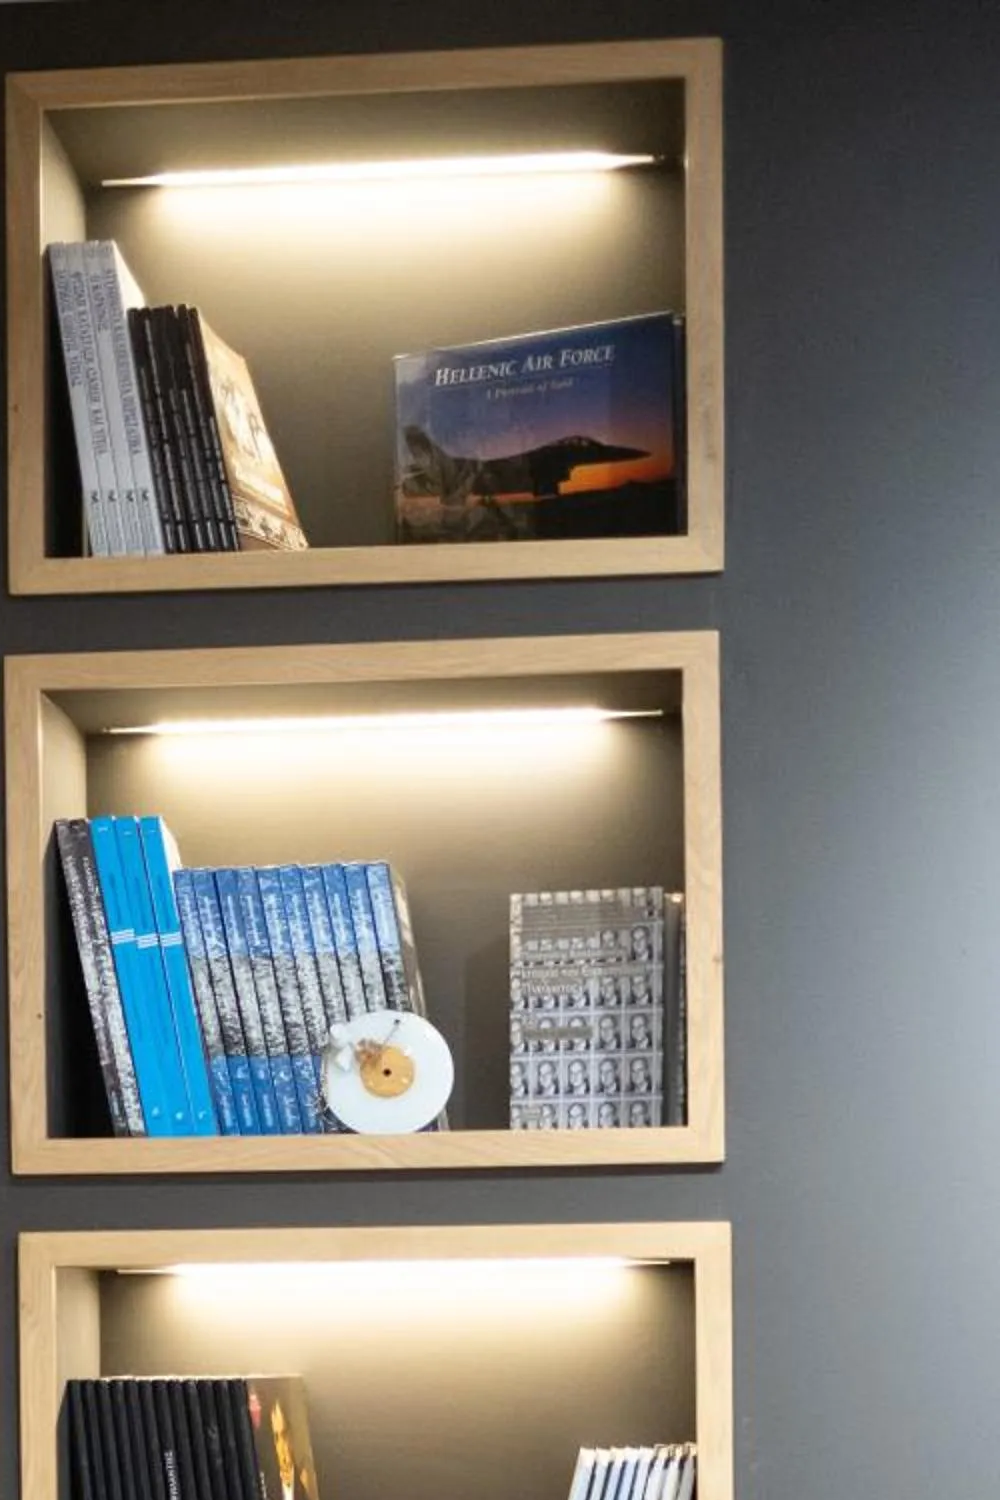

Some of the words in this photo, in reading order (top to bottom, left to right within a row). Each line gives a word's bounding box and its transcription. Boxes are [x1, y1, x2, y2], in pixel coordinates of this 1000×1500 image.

[435, 361, 517, 386] HELLENIC
[521, 355, 553, 373] AIR
[560, 344, 616, 367] FORCE
